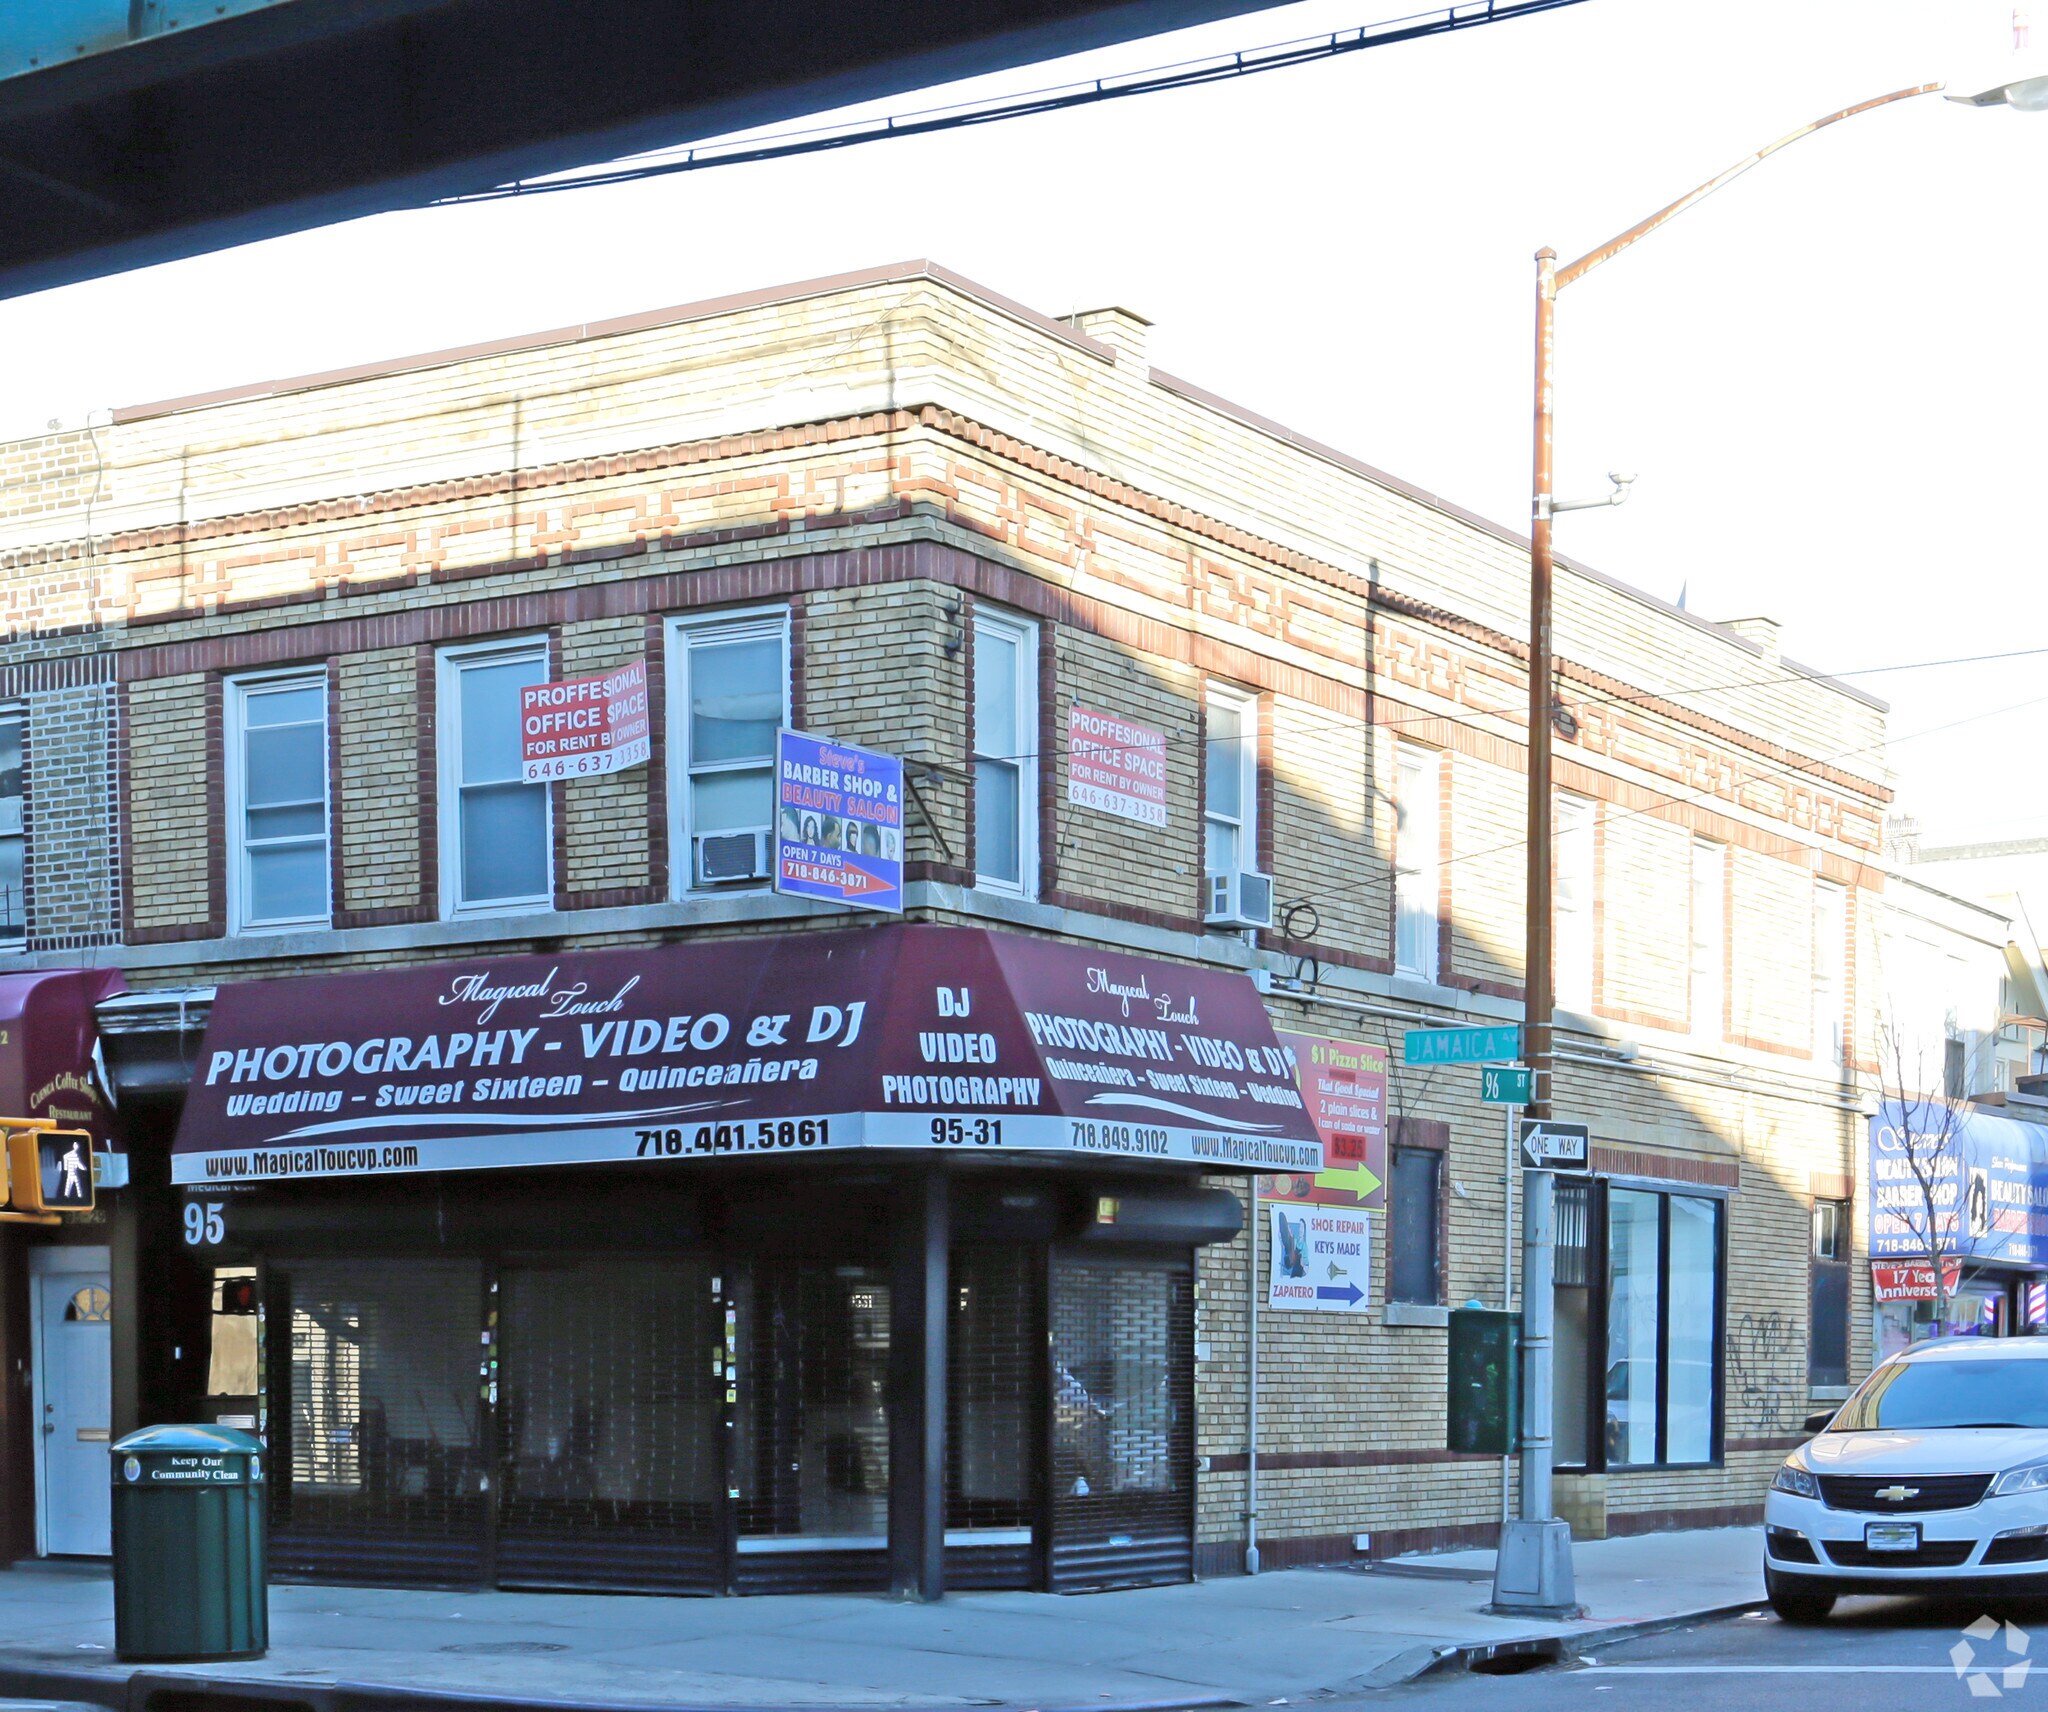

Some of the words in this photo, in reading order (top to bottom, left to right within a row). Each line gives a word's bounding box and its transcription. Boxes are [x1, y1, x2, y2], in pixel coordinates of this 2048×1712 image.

[525, 667, 644, 708] PROFFESIONAL
[526, 707, 601, 735] OFFICE
[607, 692, 645, 724] SPACE
[526, 740, 556, 756] FOR
[560, 734, 598, 751] RENT
[601, 732, 616, 746] BY
[617, 719, 646, 741] OWNER
[1072, 712, 1164, 756] PROFFESIONAL
[528, 741, 646, 779] 646-637-3358
[819, 746, 865, 774] Steve's
[1072, 738, 1121, 768] OFFICE
[1124, 752, 1164, 780] SPACE
[784, 760, 839, 790] BARBER
[844, 774, 882, 798] SHOP
[886, 784, 898, 802] &
[1072, 764, 1092, 780] FOR
[1094, 769, 1118, 786] RENT
[1120, 777, 1132, 790] BY
[1133, 781, 1164, 800] OWNER
[782, 783, 842, 812] BEAUTY
[848, 797, 898, 825] SALON
[1072, 786, 1164, 822] 646-637-3358
[783, 846, 808, 862] OPEN
[811, 851, 817, 862] 7
[820, 852, 842, 867] DAYS
[787, 863, 868, 889] 718-846-3871
[438, 966, 558, 1025] Magical
[539, 975, 640, 1018] Touch
[937, 986, 970, 1018] DJ
[1086, 968, 1150, 1018] Magical
[1154, 994, 1200, 1026] Touch
[205, 1028, 540, 1086] PHOTOGRAPHY
[580, 1013, 730, 1058] VIDEO
[746, 1014, 791, 1048] &
[806, 1002, 866, 1048] DJ
[919, 1032, 997, 1064] VIDEO
[1024, 1011, 1174, 1062] PHOTOGRAPHY
[1180, 1034, 1244, 1072] VIDEO
[1244, 1048, 1266, 1075] &
[1262, 1046, 1290, 1080] DJ
[1312, 1044, 1325, 1064] $1
[1329, 1048, 1358, 1069] Pizza
[1360, 1054, 1384, 1074] Slice
[1410, 1032, 1497, 1060] JAMAICA
[226, 1090, 343, 1117] Wedding
[376, 1080, 464, 1108] Sweet
[472, 1074, 582, 1102] Sixteen
[619, 1058, 818, 1092] Quinceañera
[882, 1075, 1040, 1106] PHOTOGRAPHY
[1044, 1057, 1137, 1088] Quinceañera
[1146, 1069, 1190, 1094] Sweet
[1192, 1073, 1240, 1100] Sixteen
[1247, 1082, 1303, 1110] Wedding
[1486, 1072, 1499, 1098] 96
[1517, 1074, 1526, 1088] ST
[1320, 1100, 1326, 1113] 2
[1328, 1101, 1348, 1116] plain
[1349, 1104, 1370, 1120] slices
[1371, 1107, 1378, 1120] &
[634, 1119, 830, 1157] 718.441.5861
[931, 1118, 1002, 1145] 95-31
[1071, 1122, 1168, 1154] 718.849.9102
[1322, 1120, 1333, 1128] can
[1334, 1120, 1341, 1130] of
[1342, 1120, 1356, 1132] soda
[1357, 1124, 1363, 1132] or
[1364, 1125, 1380, 1136] water
[1531, 1136, 1550, 1154] ONE
[1558, 1138, 1578, 1156] WAY
[1991, 1180, 2026, 1205] BEAUTY
[184, 1202, 224, 1245] 95
[1312, 1218, 1334, 1232] SHOE
[1336, 1220, 1364, 1234] REPAIR
[1874, 1214, 1910, 1234] OPEN
[1914, 1212, 1922, 1232] 7
[1314, 1241, 1334, 1254] KEYS
[1337, 1242, 1360, 1256] MADE
[1273, 1285, 1314, 1298] ZAPATERO
[1893, 1270, 1908, 1284] 17
[152, 1469, 210, 1480] Community
[213, 1470, 238, 1480] Clean
[172, 1457, 198, 1466] Keep
[202, 1457, 222, 1466] Our
